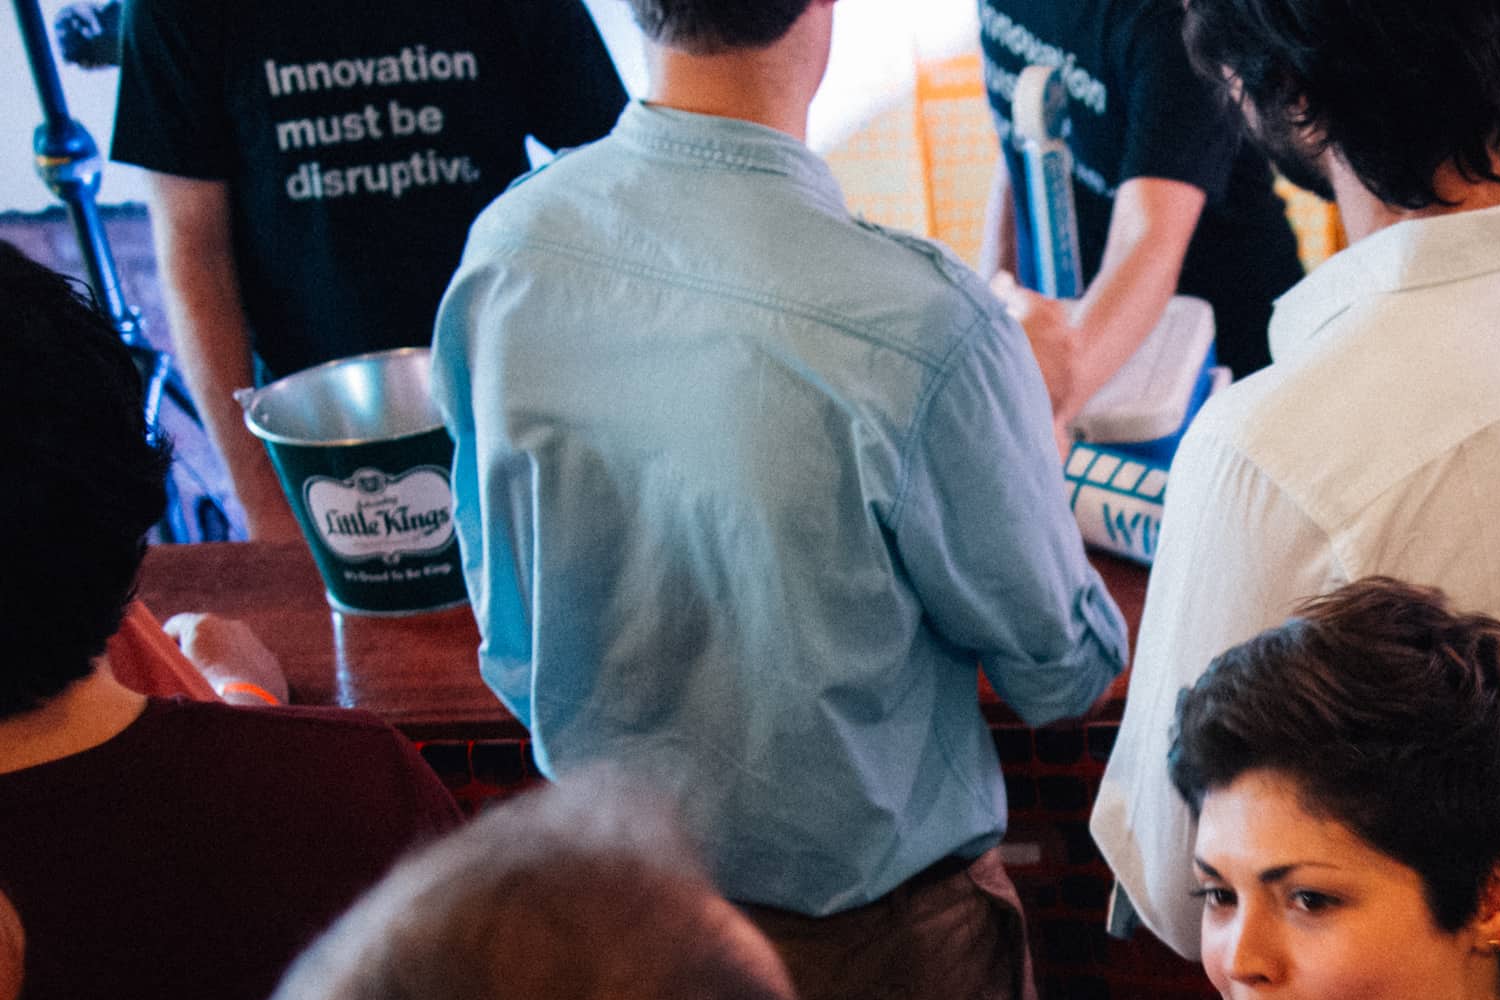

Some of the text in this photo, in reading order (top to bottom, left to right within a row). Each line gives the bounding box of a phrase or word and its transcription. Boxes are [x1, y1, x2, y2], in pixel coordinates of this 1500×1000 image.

[265, 44, 477, 97] Innovation
[276, 100, 443, 150] must be
[325, 507, 377, 536] Little
[377, 504, 451, 537] Kings
